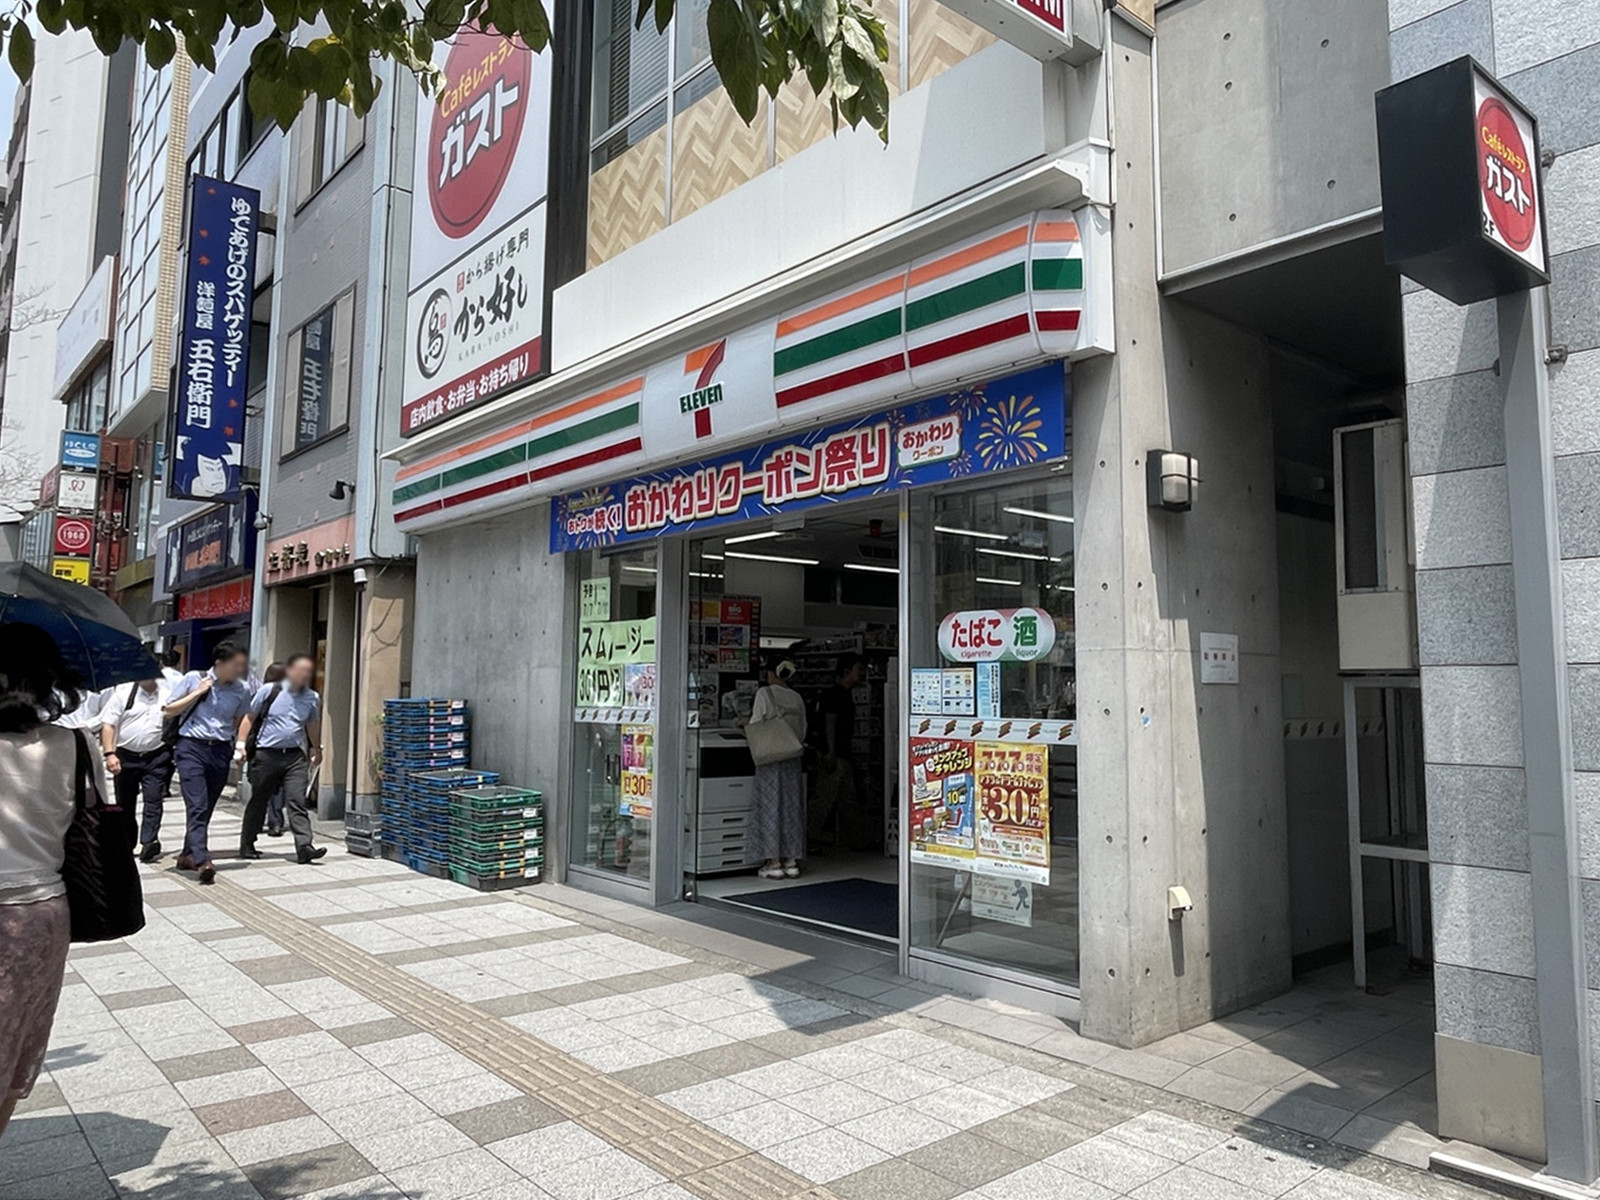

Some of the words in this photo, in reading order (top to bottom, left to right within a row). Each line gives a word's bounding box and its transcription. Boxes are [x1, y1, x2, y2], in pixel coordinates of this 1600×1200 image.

[438, 77, 520, 189] ガスト
[1486, 155, 1531, 215] ガスト
[466, 228, 529, 284] から揚げ専門
[223, 196, 251, 387] ゆであげのスパゲッティー
[454, 266, 527, 342] から好し
[186, 339, 214, 429] 五右衛門
[684, 337, 727, 438] 7
[902, 421, 953, 450] おかわり
[911, 444, 945, 461] クーポン
[625, 422, 890, 532] おかわりクーポン祭り
[581, 625, 655, 661] スムージー
[951, 616, 1003, 648] たばこ
[1013, 615, 1038, 647] 酒
[961, 650, 992, 659] cigarette
[1016, 648, 1038, 657] liquor
[631, 775, 646, 796] 30
[988, 786, 1030, 825] 30
